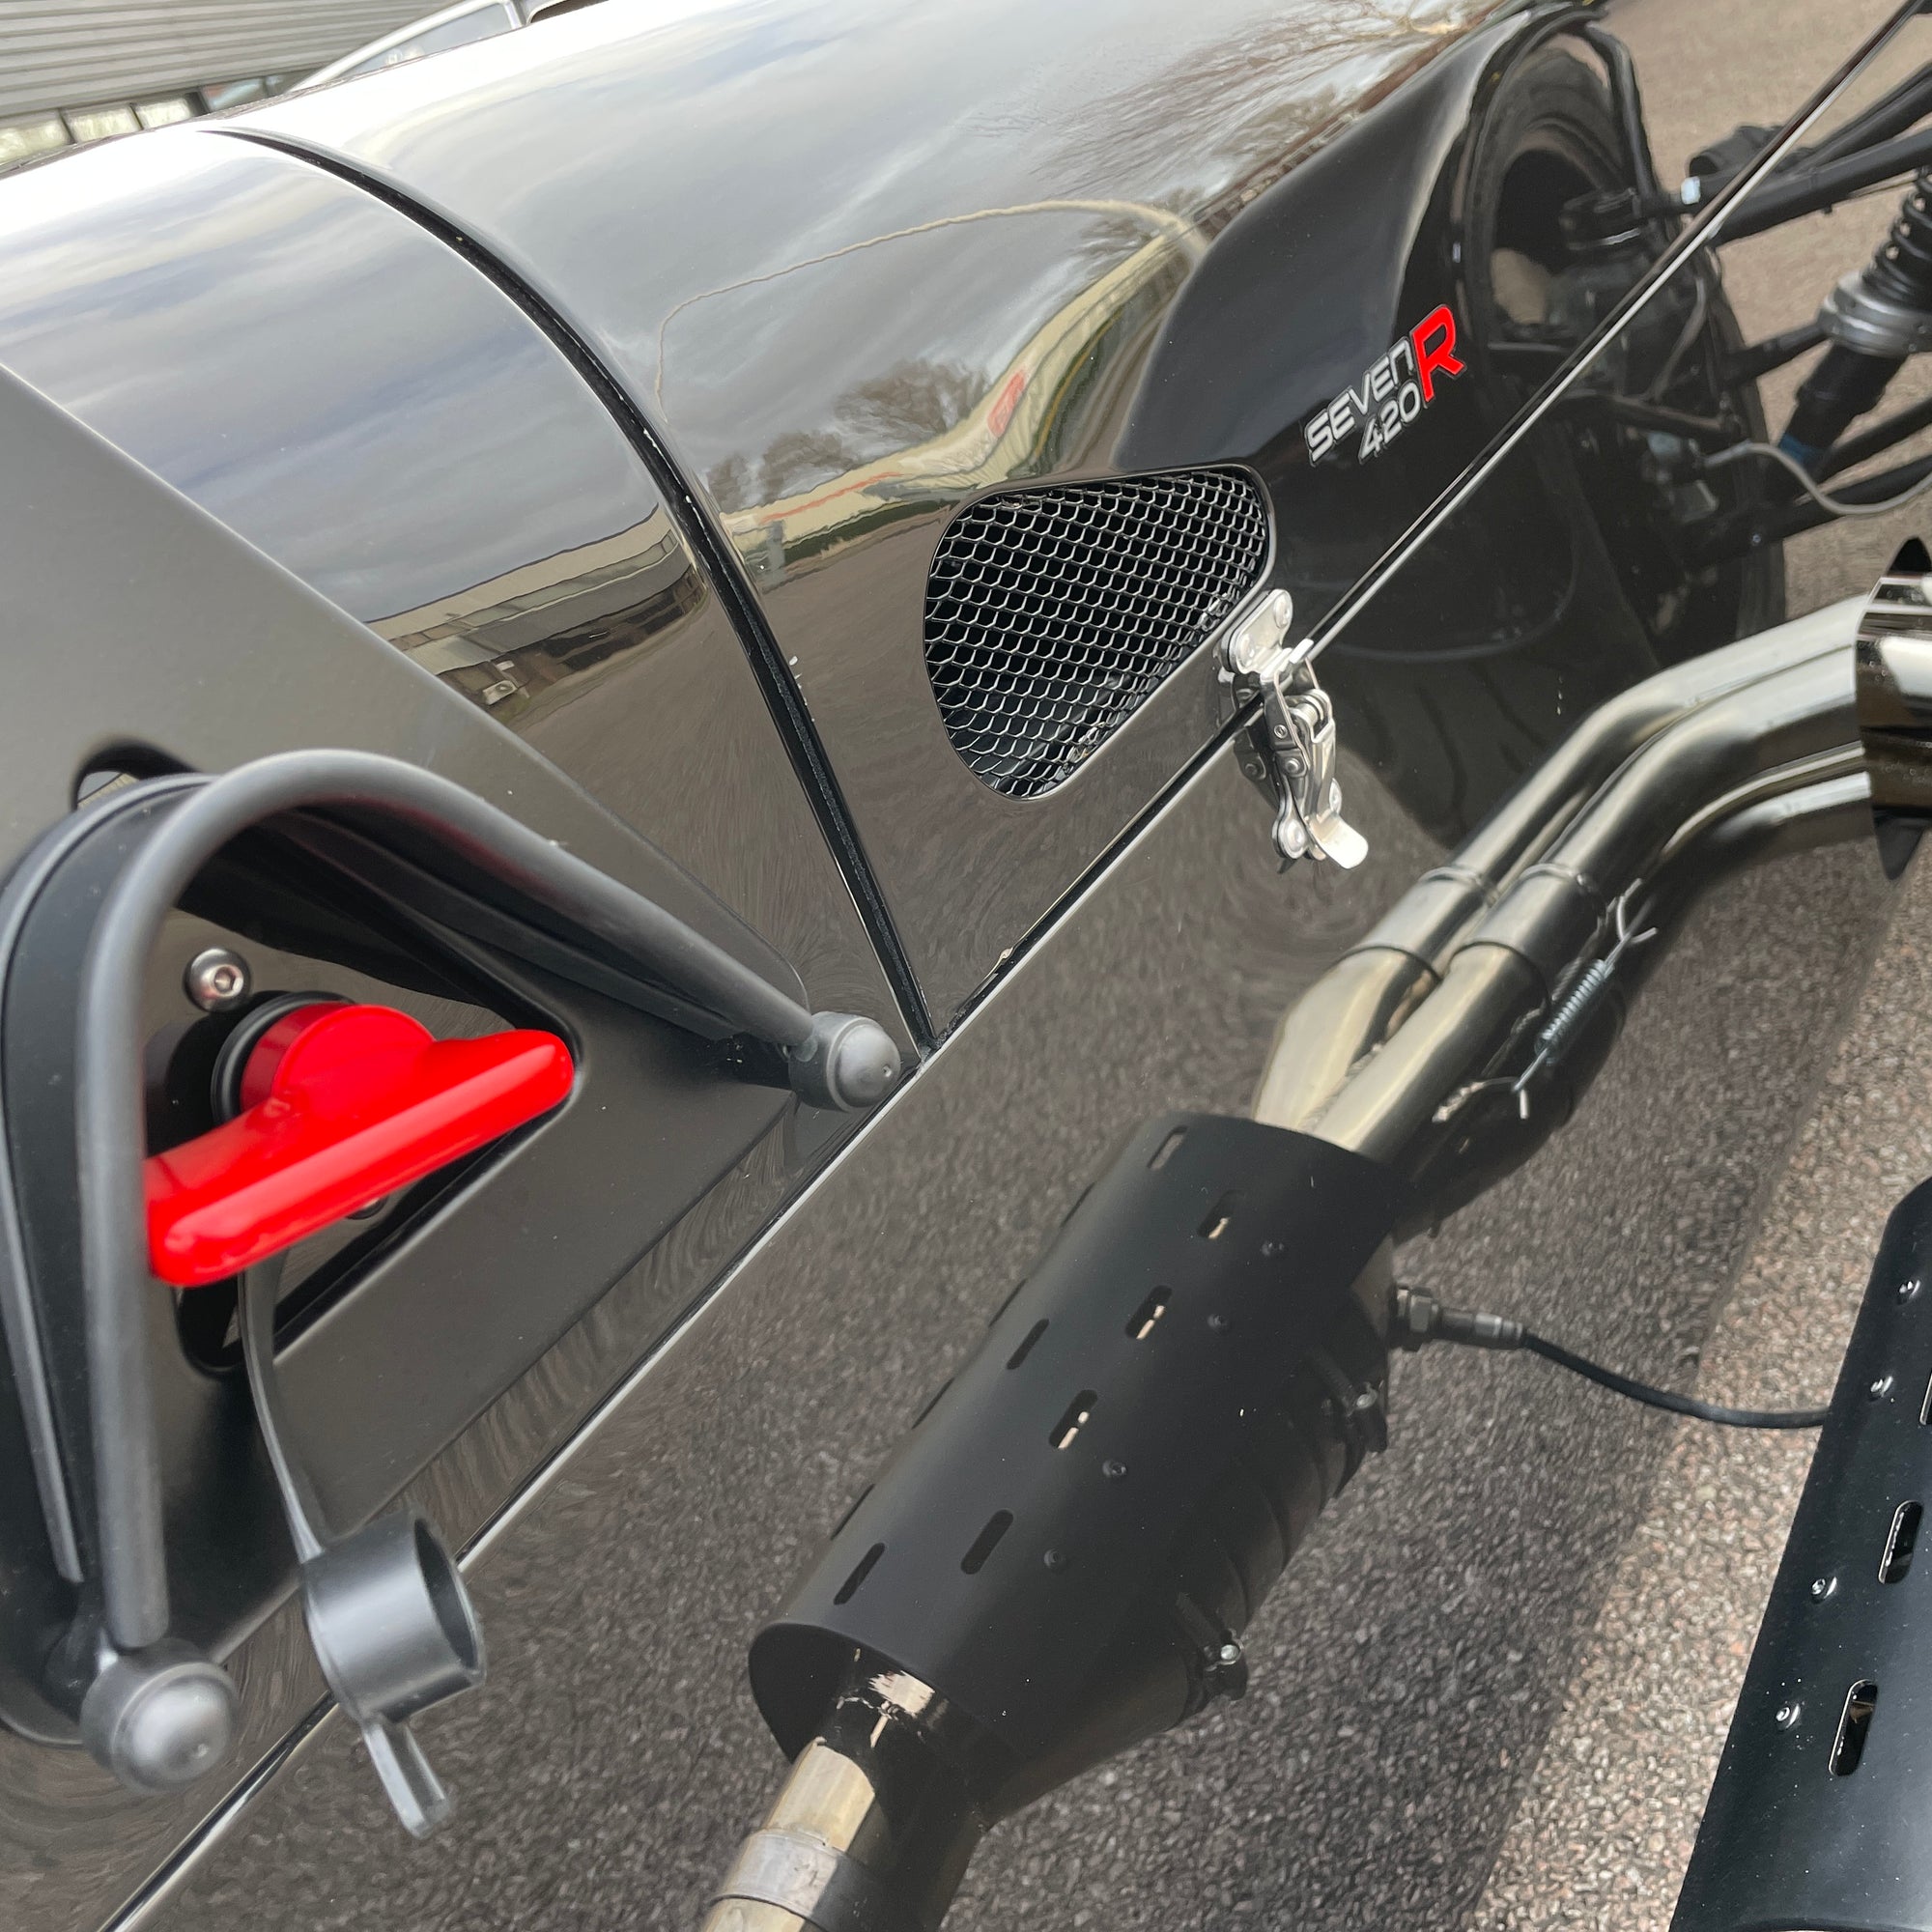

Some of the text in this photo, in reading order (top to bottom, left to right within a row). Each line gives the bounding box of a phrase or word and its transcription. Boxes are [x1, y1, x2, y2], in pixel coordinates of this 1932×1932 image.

[1306, 338, 1414, 463] SEVEN
[1360, 305, 1464, 460] 420 R
